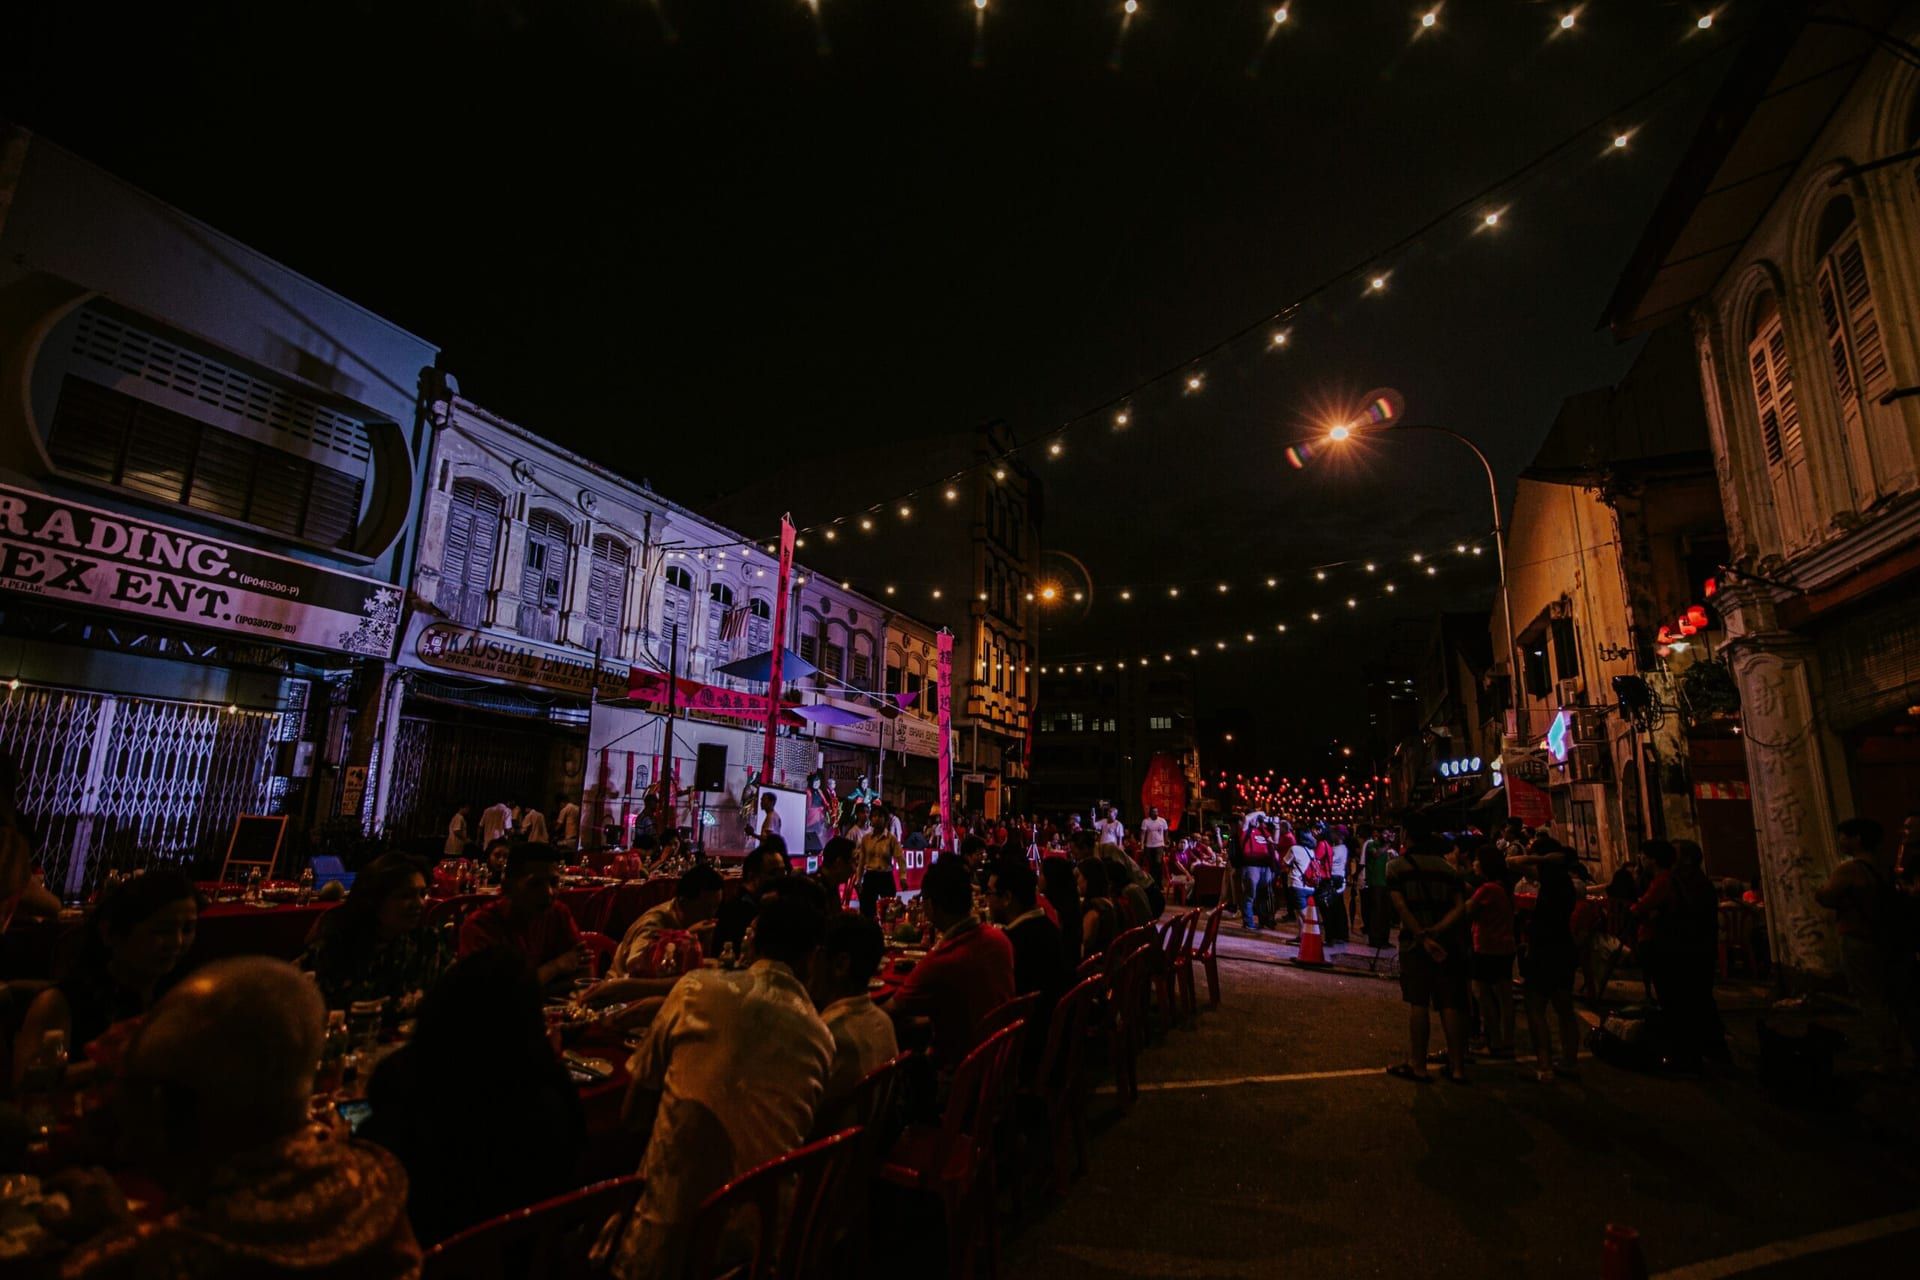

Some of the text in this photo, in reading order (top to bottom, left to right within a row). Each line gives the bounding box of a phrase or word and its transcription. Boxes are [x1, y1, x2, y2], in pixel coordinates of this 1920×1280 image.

[111, 568, 232, 620] ENT.
[447, 631, 538, 668] KAUSHAL
[541, 652, 630, 686] ENTERPRIS
[471, 658, 496, 671] JALAN
